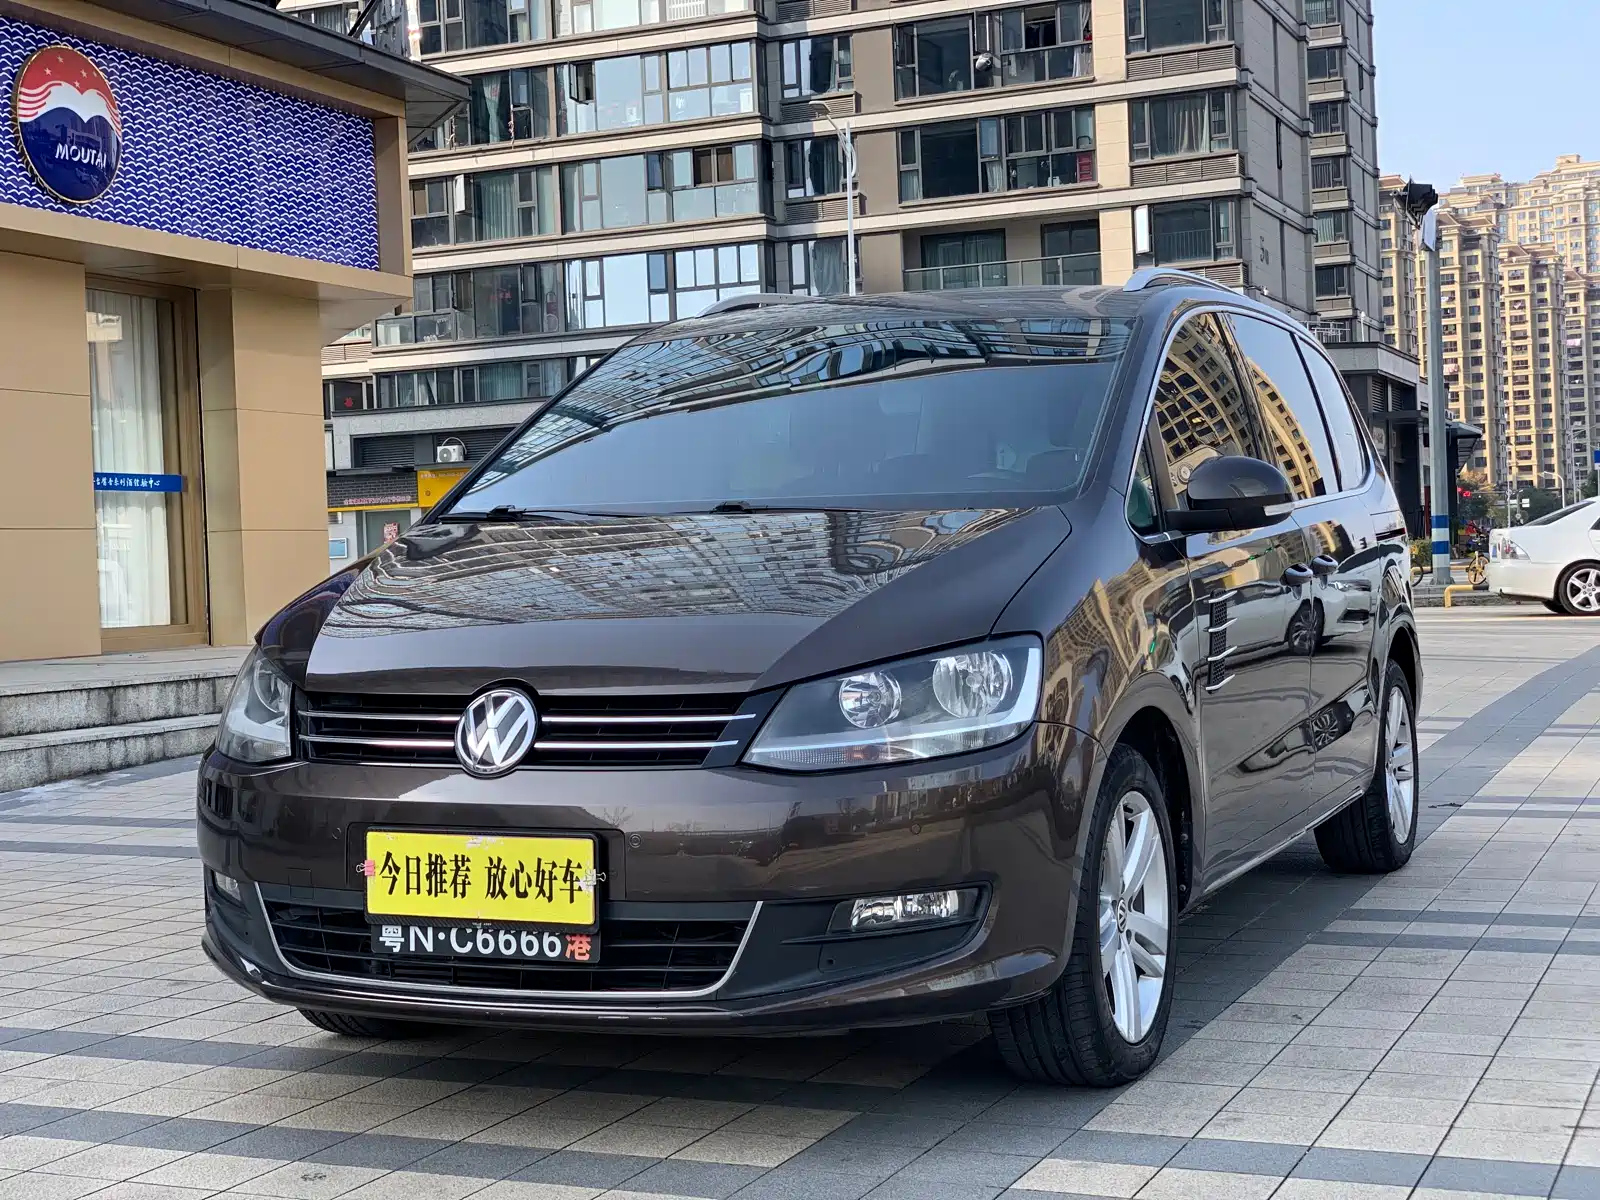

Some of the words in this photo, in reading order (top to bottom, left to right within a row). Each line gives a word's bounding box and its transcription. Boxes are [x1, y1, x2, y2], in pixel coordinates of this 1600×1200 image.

[55, 142, 107, 169] MOUTAI
[93, 476, 161, 489] 台酱香系列酒体验中心
[379, 850, 472, 900] 今日推荐
[484, 856, 583, 904] 放心好车
